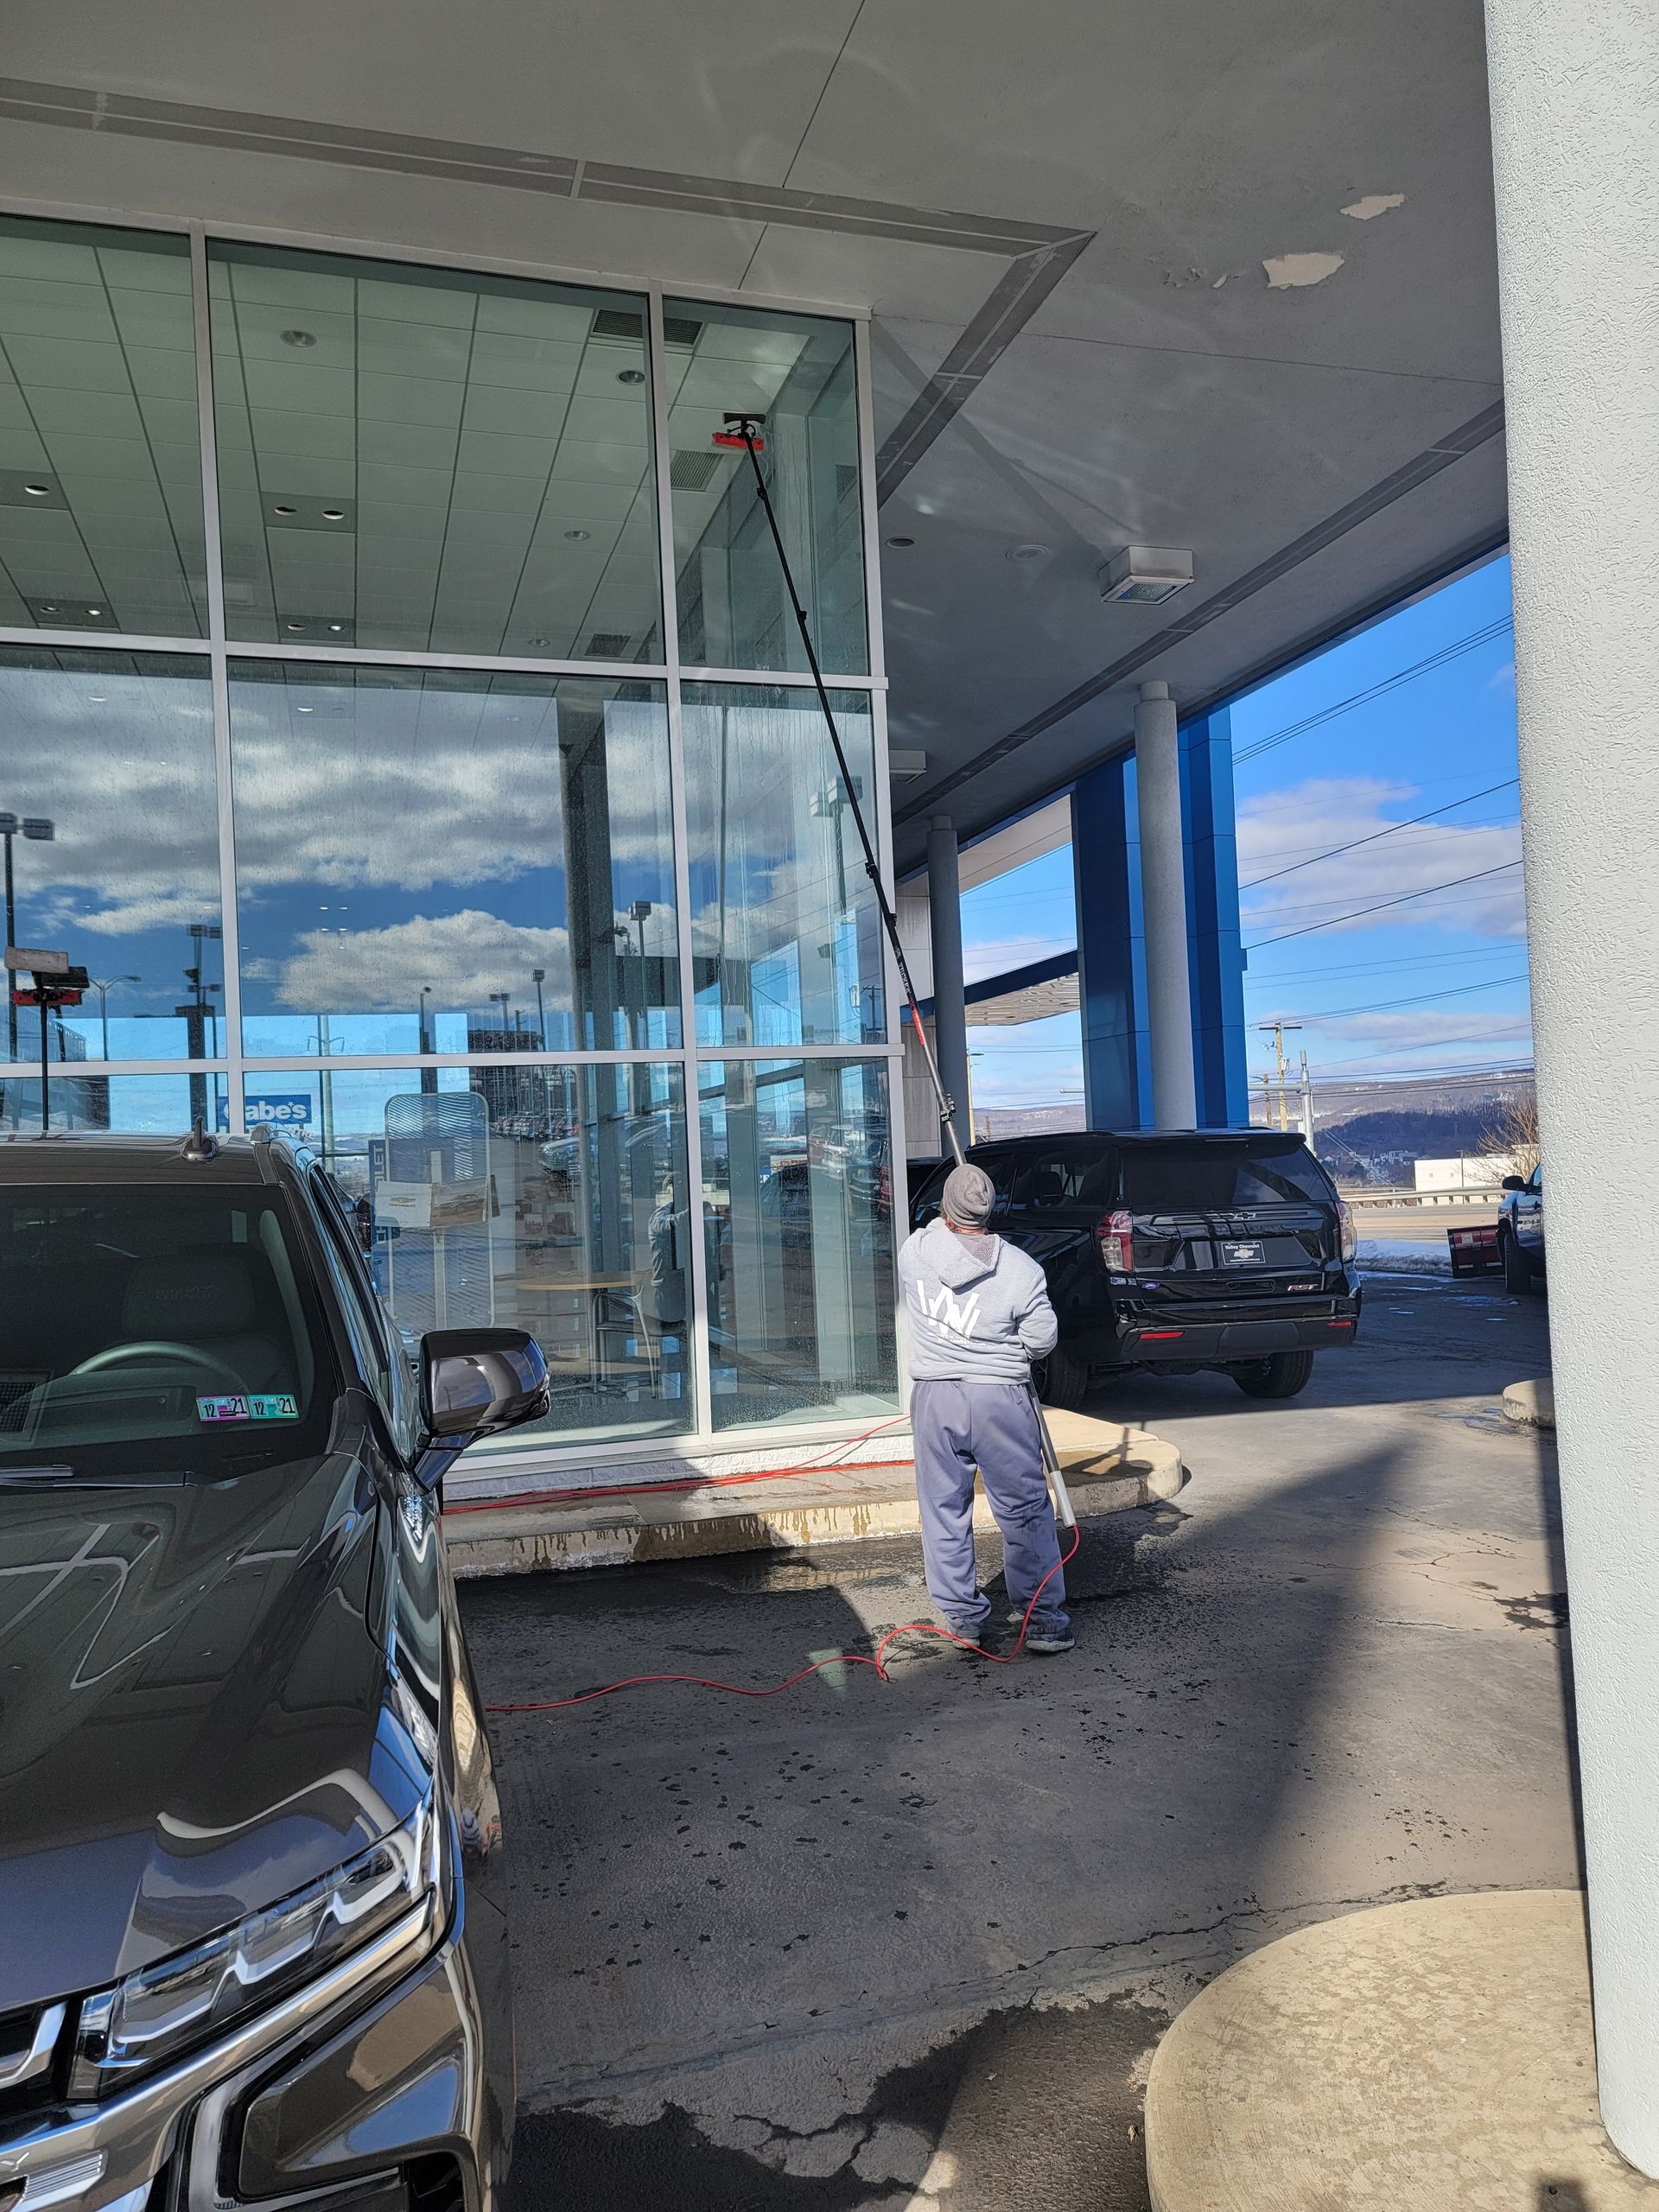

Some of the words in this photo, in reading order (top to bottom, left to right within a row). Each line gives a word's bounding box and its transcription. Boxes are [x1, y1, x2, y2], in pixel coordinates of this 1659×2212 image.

[223, 1100, 307, 1121] abe's
[203, 1403, 217, 1418] 12
[231, 1398, 247, 1414] 21
[253, 1402, 267, 1415] 12
[279, 1398, 296, 1414] 21
